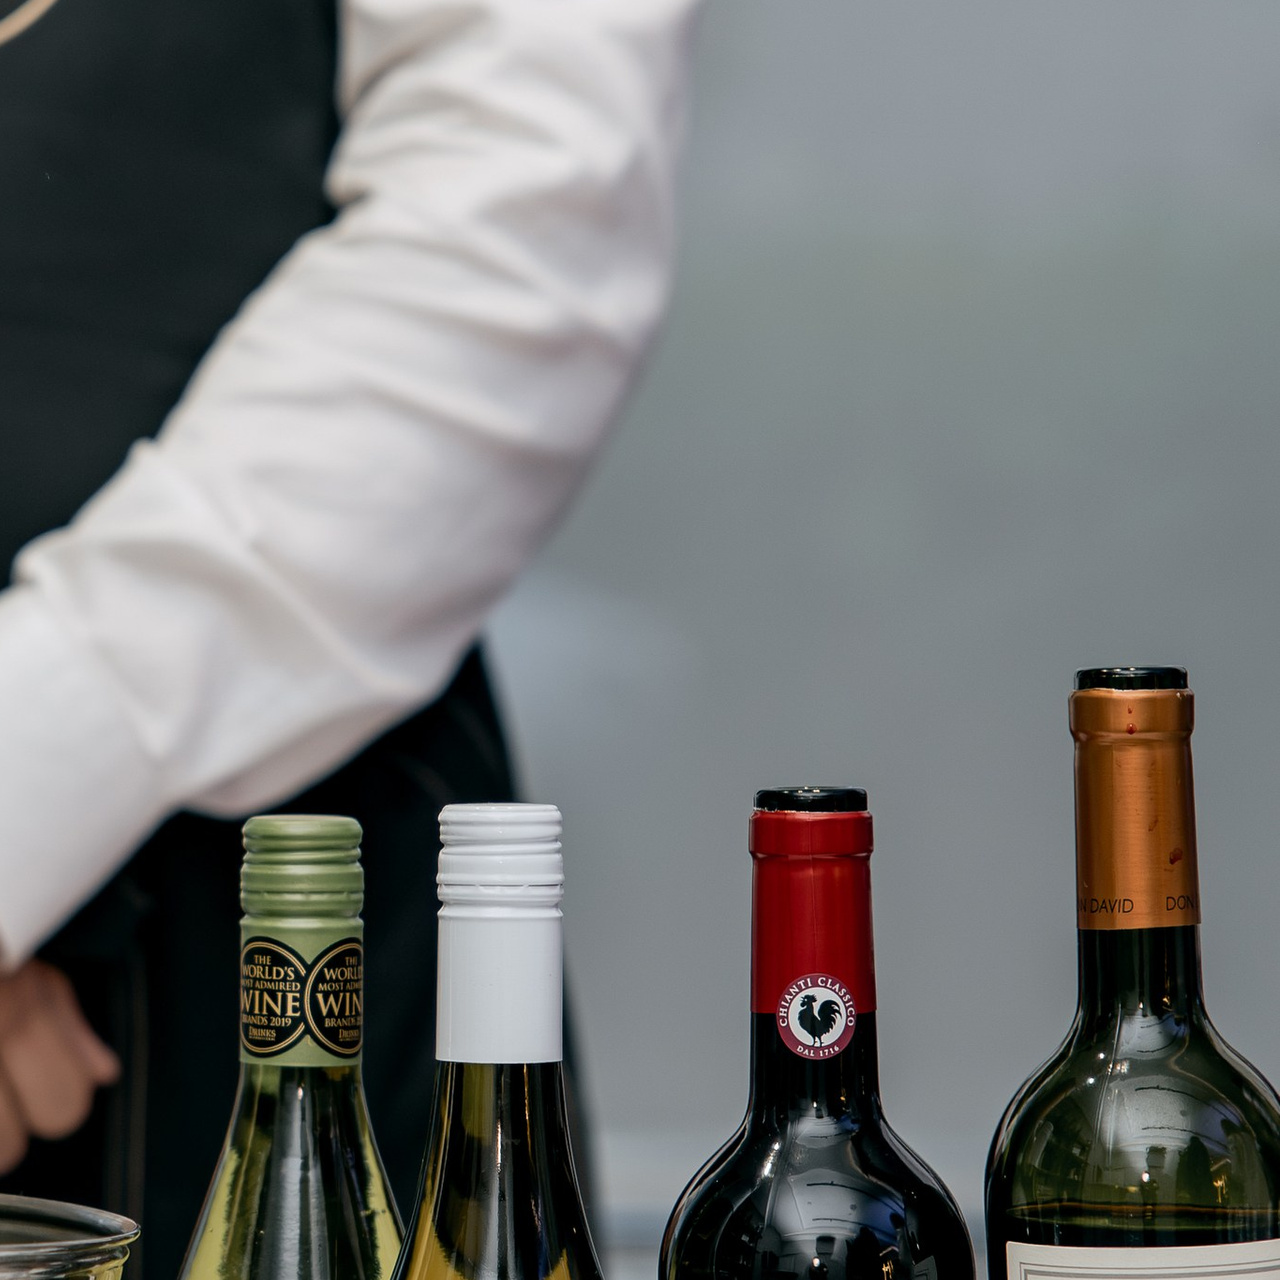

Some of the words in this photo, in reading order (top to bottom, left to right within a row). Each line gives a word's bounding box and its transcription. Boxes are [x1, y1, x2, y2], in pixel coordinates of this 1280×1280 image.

[1090, 898, 1134, 913] DAVID
[1166, 895, 1195, 911] DON
[254, 954, 271, 965] THE
[242, 964, 295, 980] WORLD'S
[255, 980, 301, 991] ADMIRED
[318, 982, 344, 991] MOST
[241, 989, 301, 1016] WINE
[779, 978, 813, 1027] CHIANTI
[817, 977, 856, 1026] CLASSICO
[270, 1017, 292, 1027] 2019
[796, 1045, 815, 1057] DAL
[819, 1045, 840, 1057] 1716
